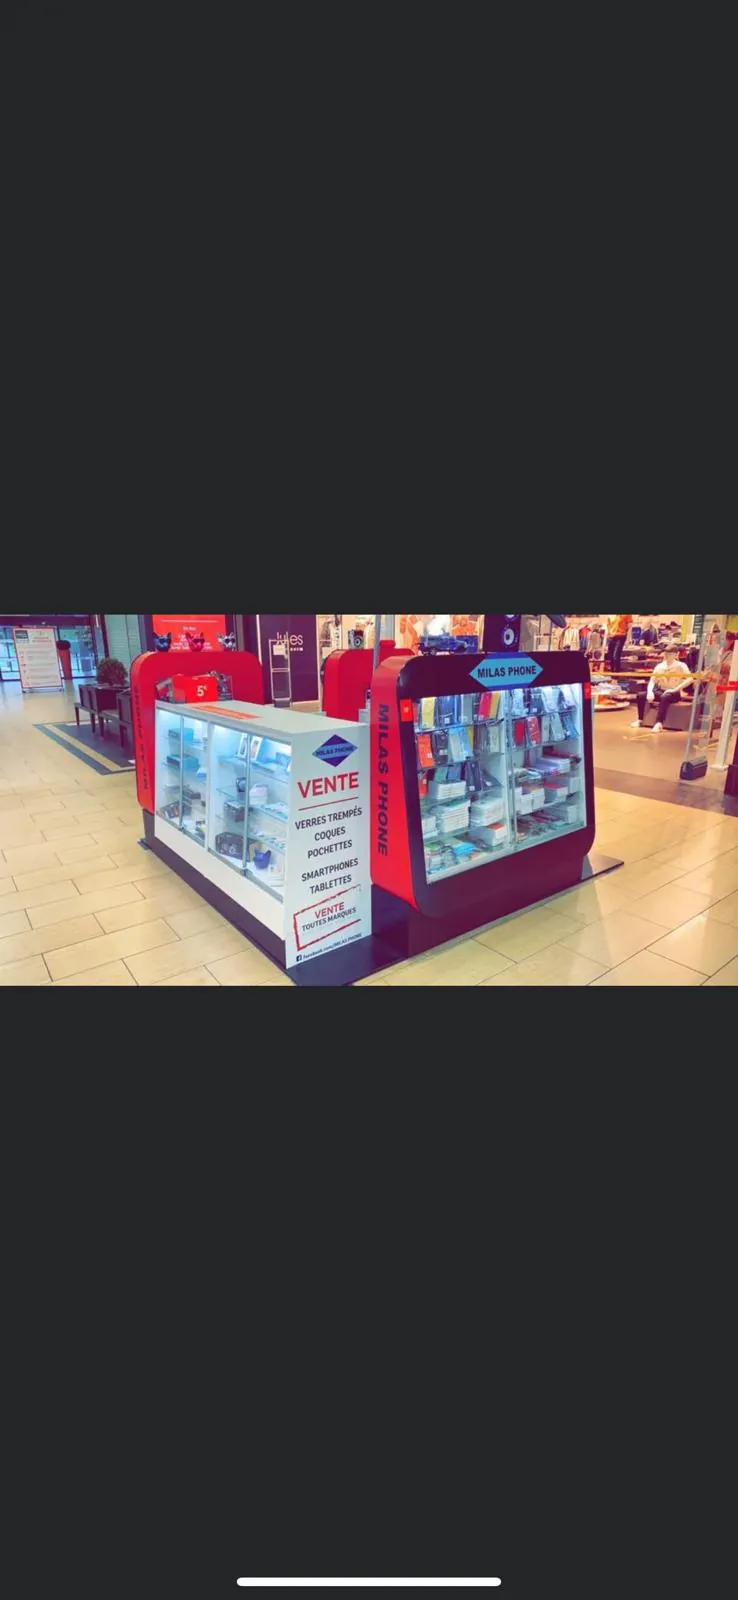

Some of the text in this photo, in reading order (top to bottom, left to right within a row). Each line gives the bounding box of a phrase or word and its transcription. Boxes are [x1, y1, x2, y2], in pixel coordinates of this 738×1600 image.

[477, 665, 537, 678] MILAS PHONE
[297, 771, 359, 799] VENTE
[378, 703, 389, 857] MILAS PHONE
[295, 805, 363, 830] VERRES TREMPÉS
[314, 826, 346, 841] COQUES
[307, 839, 353, 859] POCHETTES
[301, 857, 359, 882] SMARTPHONES
[309, 874, 352, 895] TABLETTES
[302, 906, 357, 932] TOUTES MARQUES
[315, 901, 345, 919] VENTE
